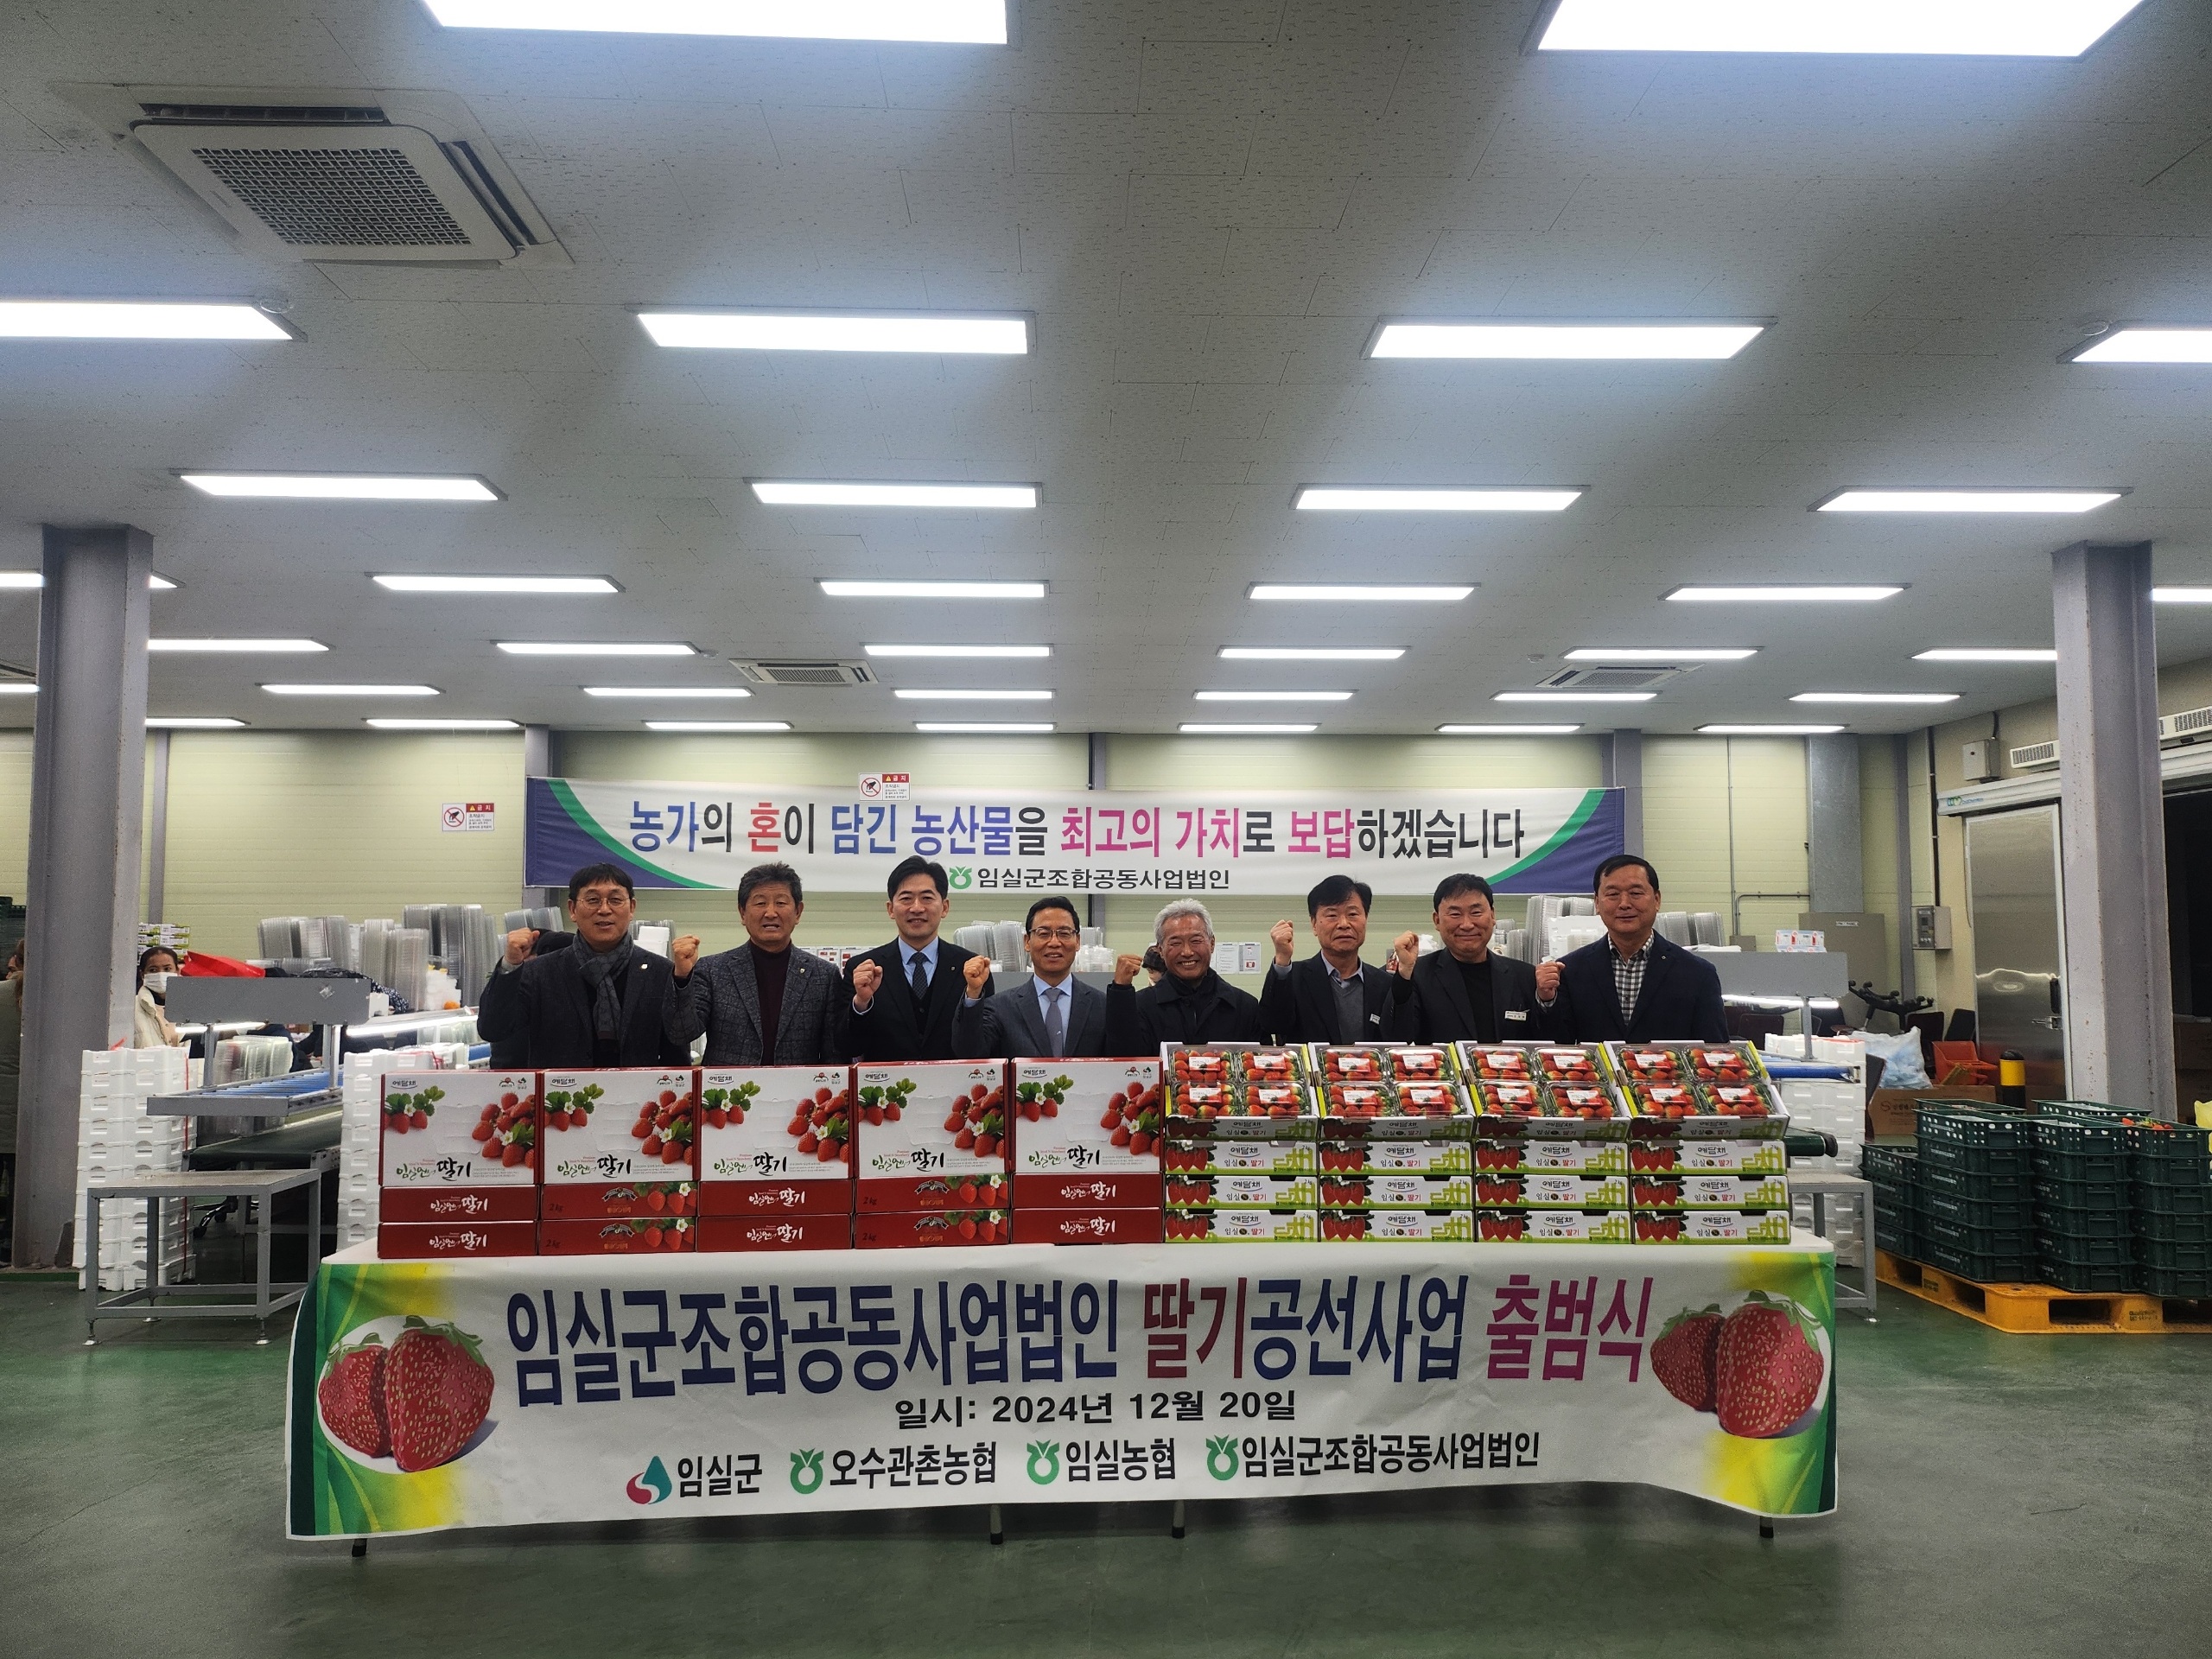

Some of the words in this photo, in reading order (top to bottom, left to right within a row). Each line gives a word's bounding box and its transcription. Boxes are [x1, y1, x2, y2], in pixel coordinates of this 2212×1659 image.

[630, 800, 733, 853] 농가의
[747, 802, 815, 855] 혼이
[831, 804, 899, 855] 담긴
[912, 804, 1049, 856] 농산물을
[1060, 805, 1161, 857] 최고의
[1175, 805, 1275, 858] 가치로
[1287, 807, 1525, 859] 보답하겠습니다
[977, 868, 1230, 890] 임실군조합공동사업법인
[596, 1154, 631, 1178] 딸기
[753, 1152, 787, 1176] 딸기
[911, 1147, 944, 1172] 딸기
[1067, 1145, 1100, 1168] 딸기
[436, 1157, 471, 1181] 딸기
[779, 1187, 805, 1207] 딸기
[1090, 1180, 1116, 1200] 딸기
[461, 1194, 488, 1214] 딸기
[777, 1224, 803, 1243] 딸기
[1090, 1216, 1116, 1236] 딸기
[461, 1230, 487, 1250] 딸기
[507, 1278, 1118, 1408] 임실군조합공동사업법인
[1143, 1274, 1469, 1382] 딸기공선사업
[1485, 1274, 1654, 1382] 출범식
[894, 1395, 977, 1429] 일시:
[992, 1392, 1114, 1423] 2024년
[1128, 1390, 1205, 1422] 12월
[1219, 1389, 1296, 1421] 20일
[677, 1453, 763, 1498] 임실군
[830, 1440, 997, 1490] 오수관촌농협
[1065, 1436, 1176, 1482] 임실농협
[1242, 1431, 1541, 1478] 임실군조합공동사업법인
